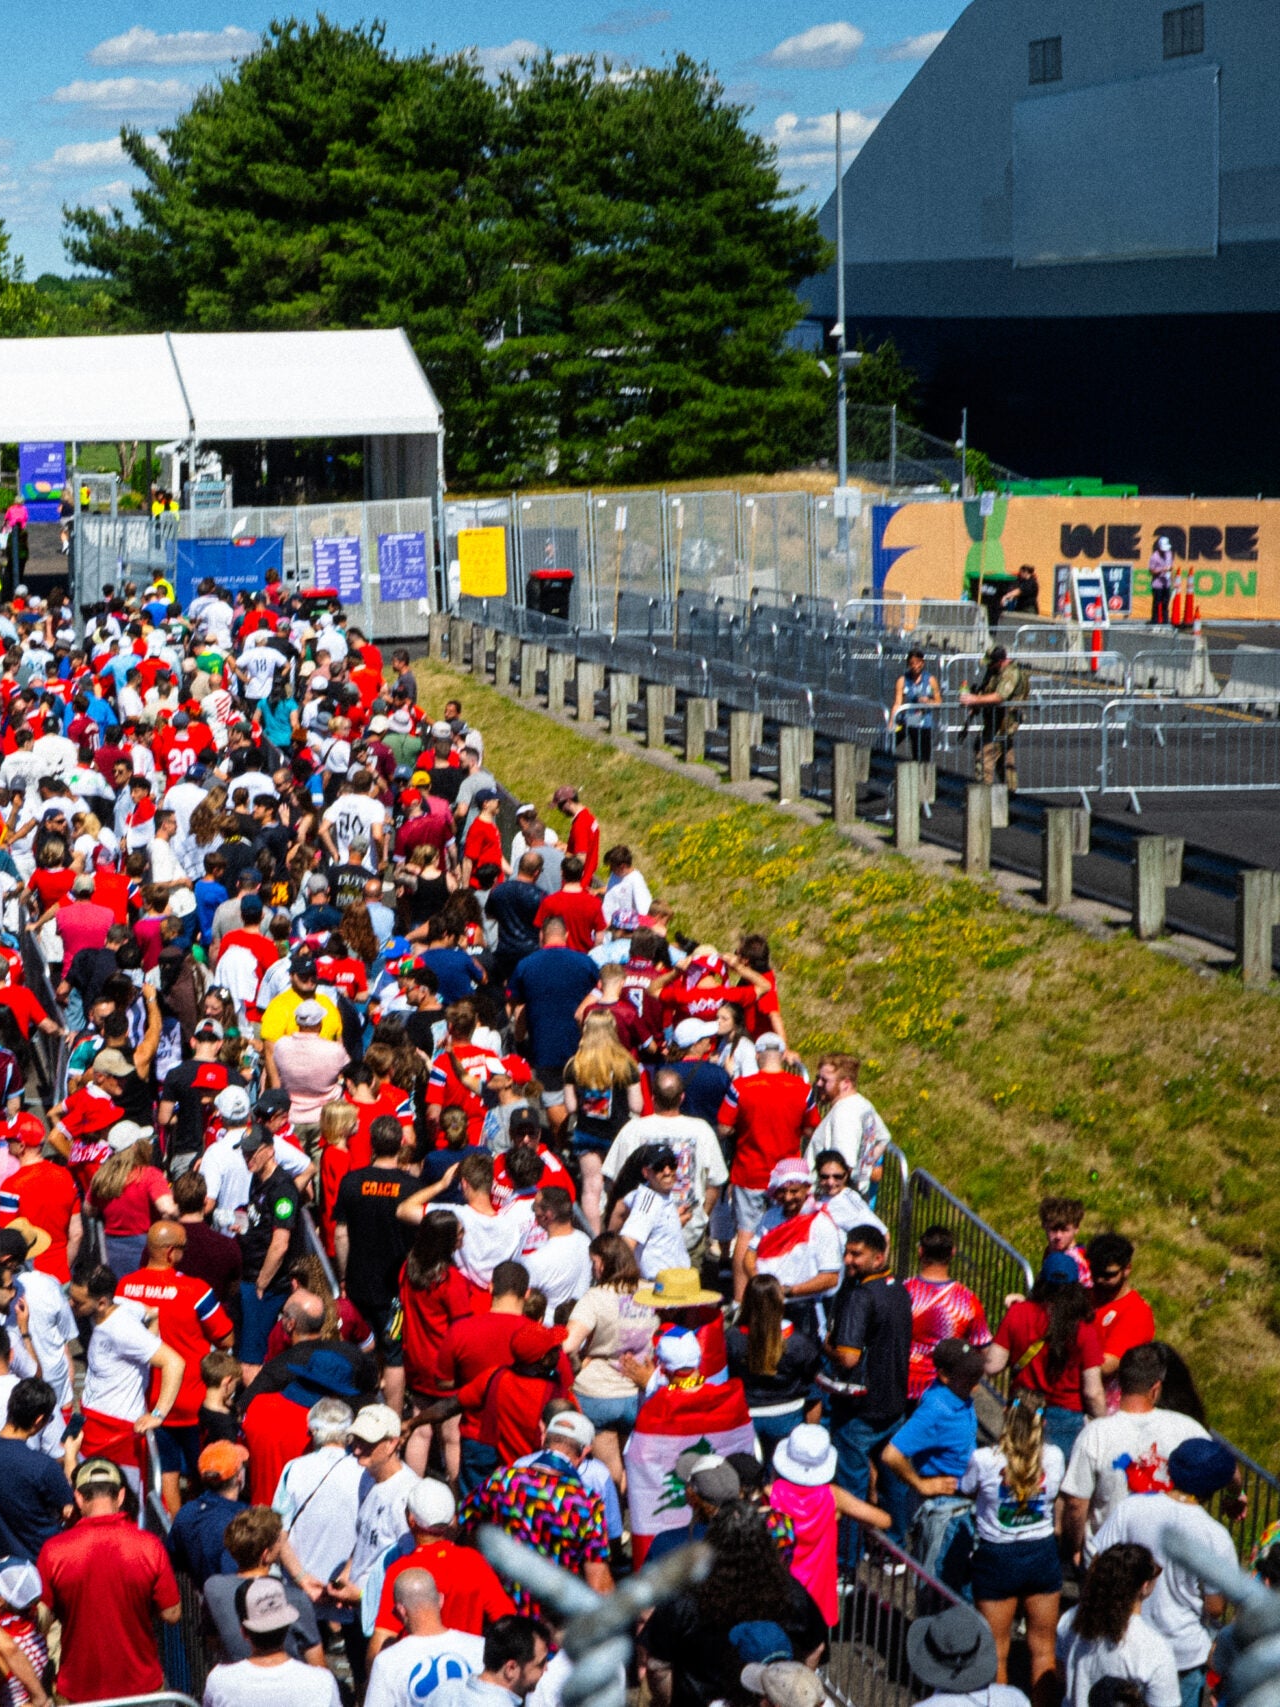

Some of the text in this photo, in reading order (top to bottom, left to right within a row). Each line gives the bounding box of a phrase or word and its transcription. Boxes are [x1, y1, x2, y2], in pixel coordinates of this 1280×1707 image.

[1060, 523, 1260, 561] WE ARE
[167, 748, 197, 775] 20
[361, 1180, 401, 1198] COACH
